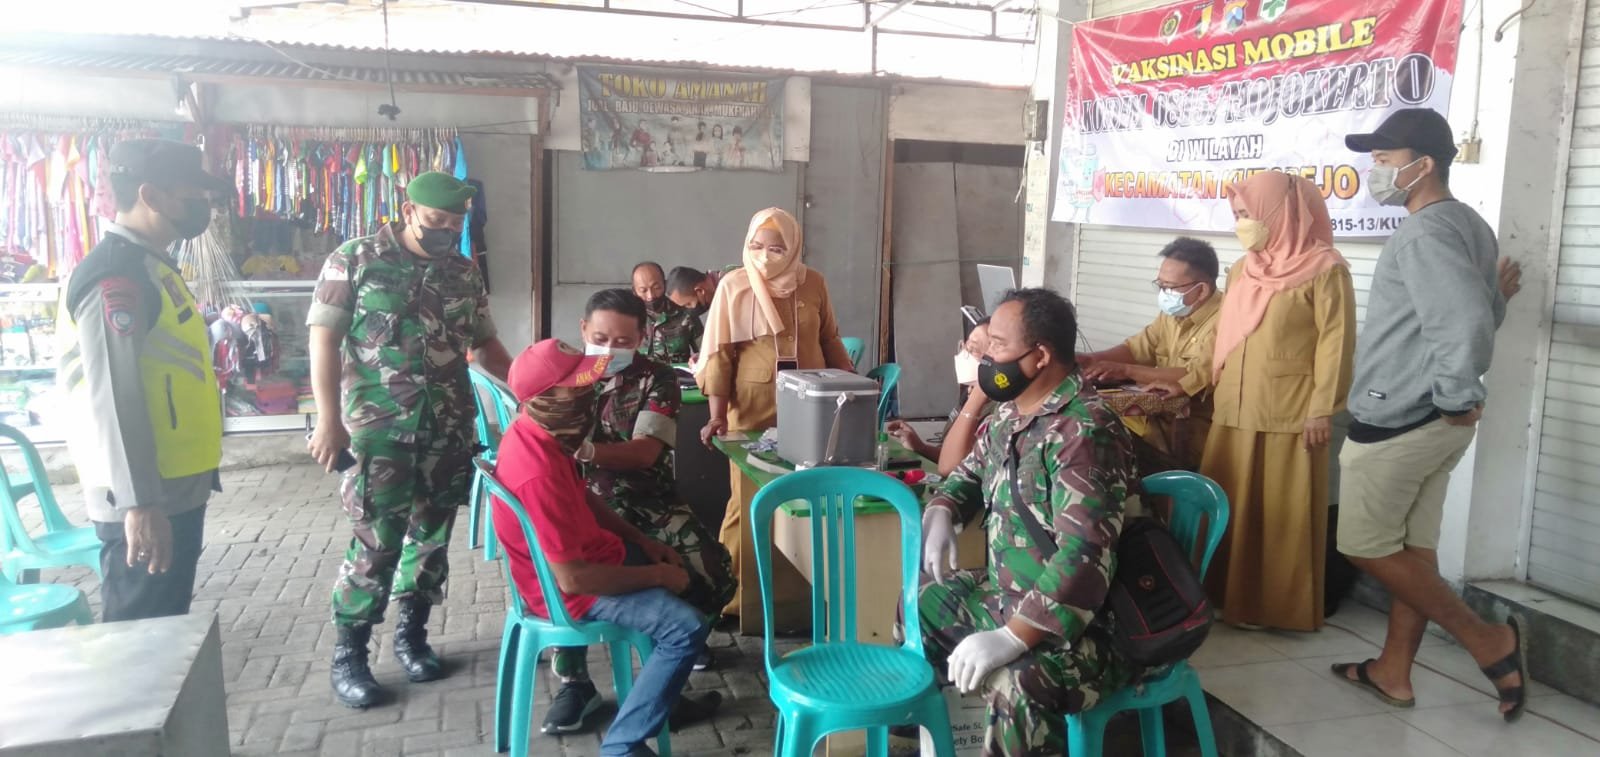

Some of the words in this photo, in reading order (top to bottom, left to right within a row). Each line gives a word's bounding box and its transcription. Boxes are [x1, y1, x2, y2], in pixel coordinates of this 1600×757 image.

[1111, 43, 1238, 85] VAKSINASI
[1243, 16, 1377, 66] MOBILE
[597, 73, 667, 98] TOKO
[673, 80, 768, 103] AMANAH
[1166, 139, 1185, 162] DI
[1187, 134, 1264, 161] WILAYAH
[1104, 170, 1218, 199] KECAMATAN
[1330, 216, 1405, 232] 815-13/KU
